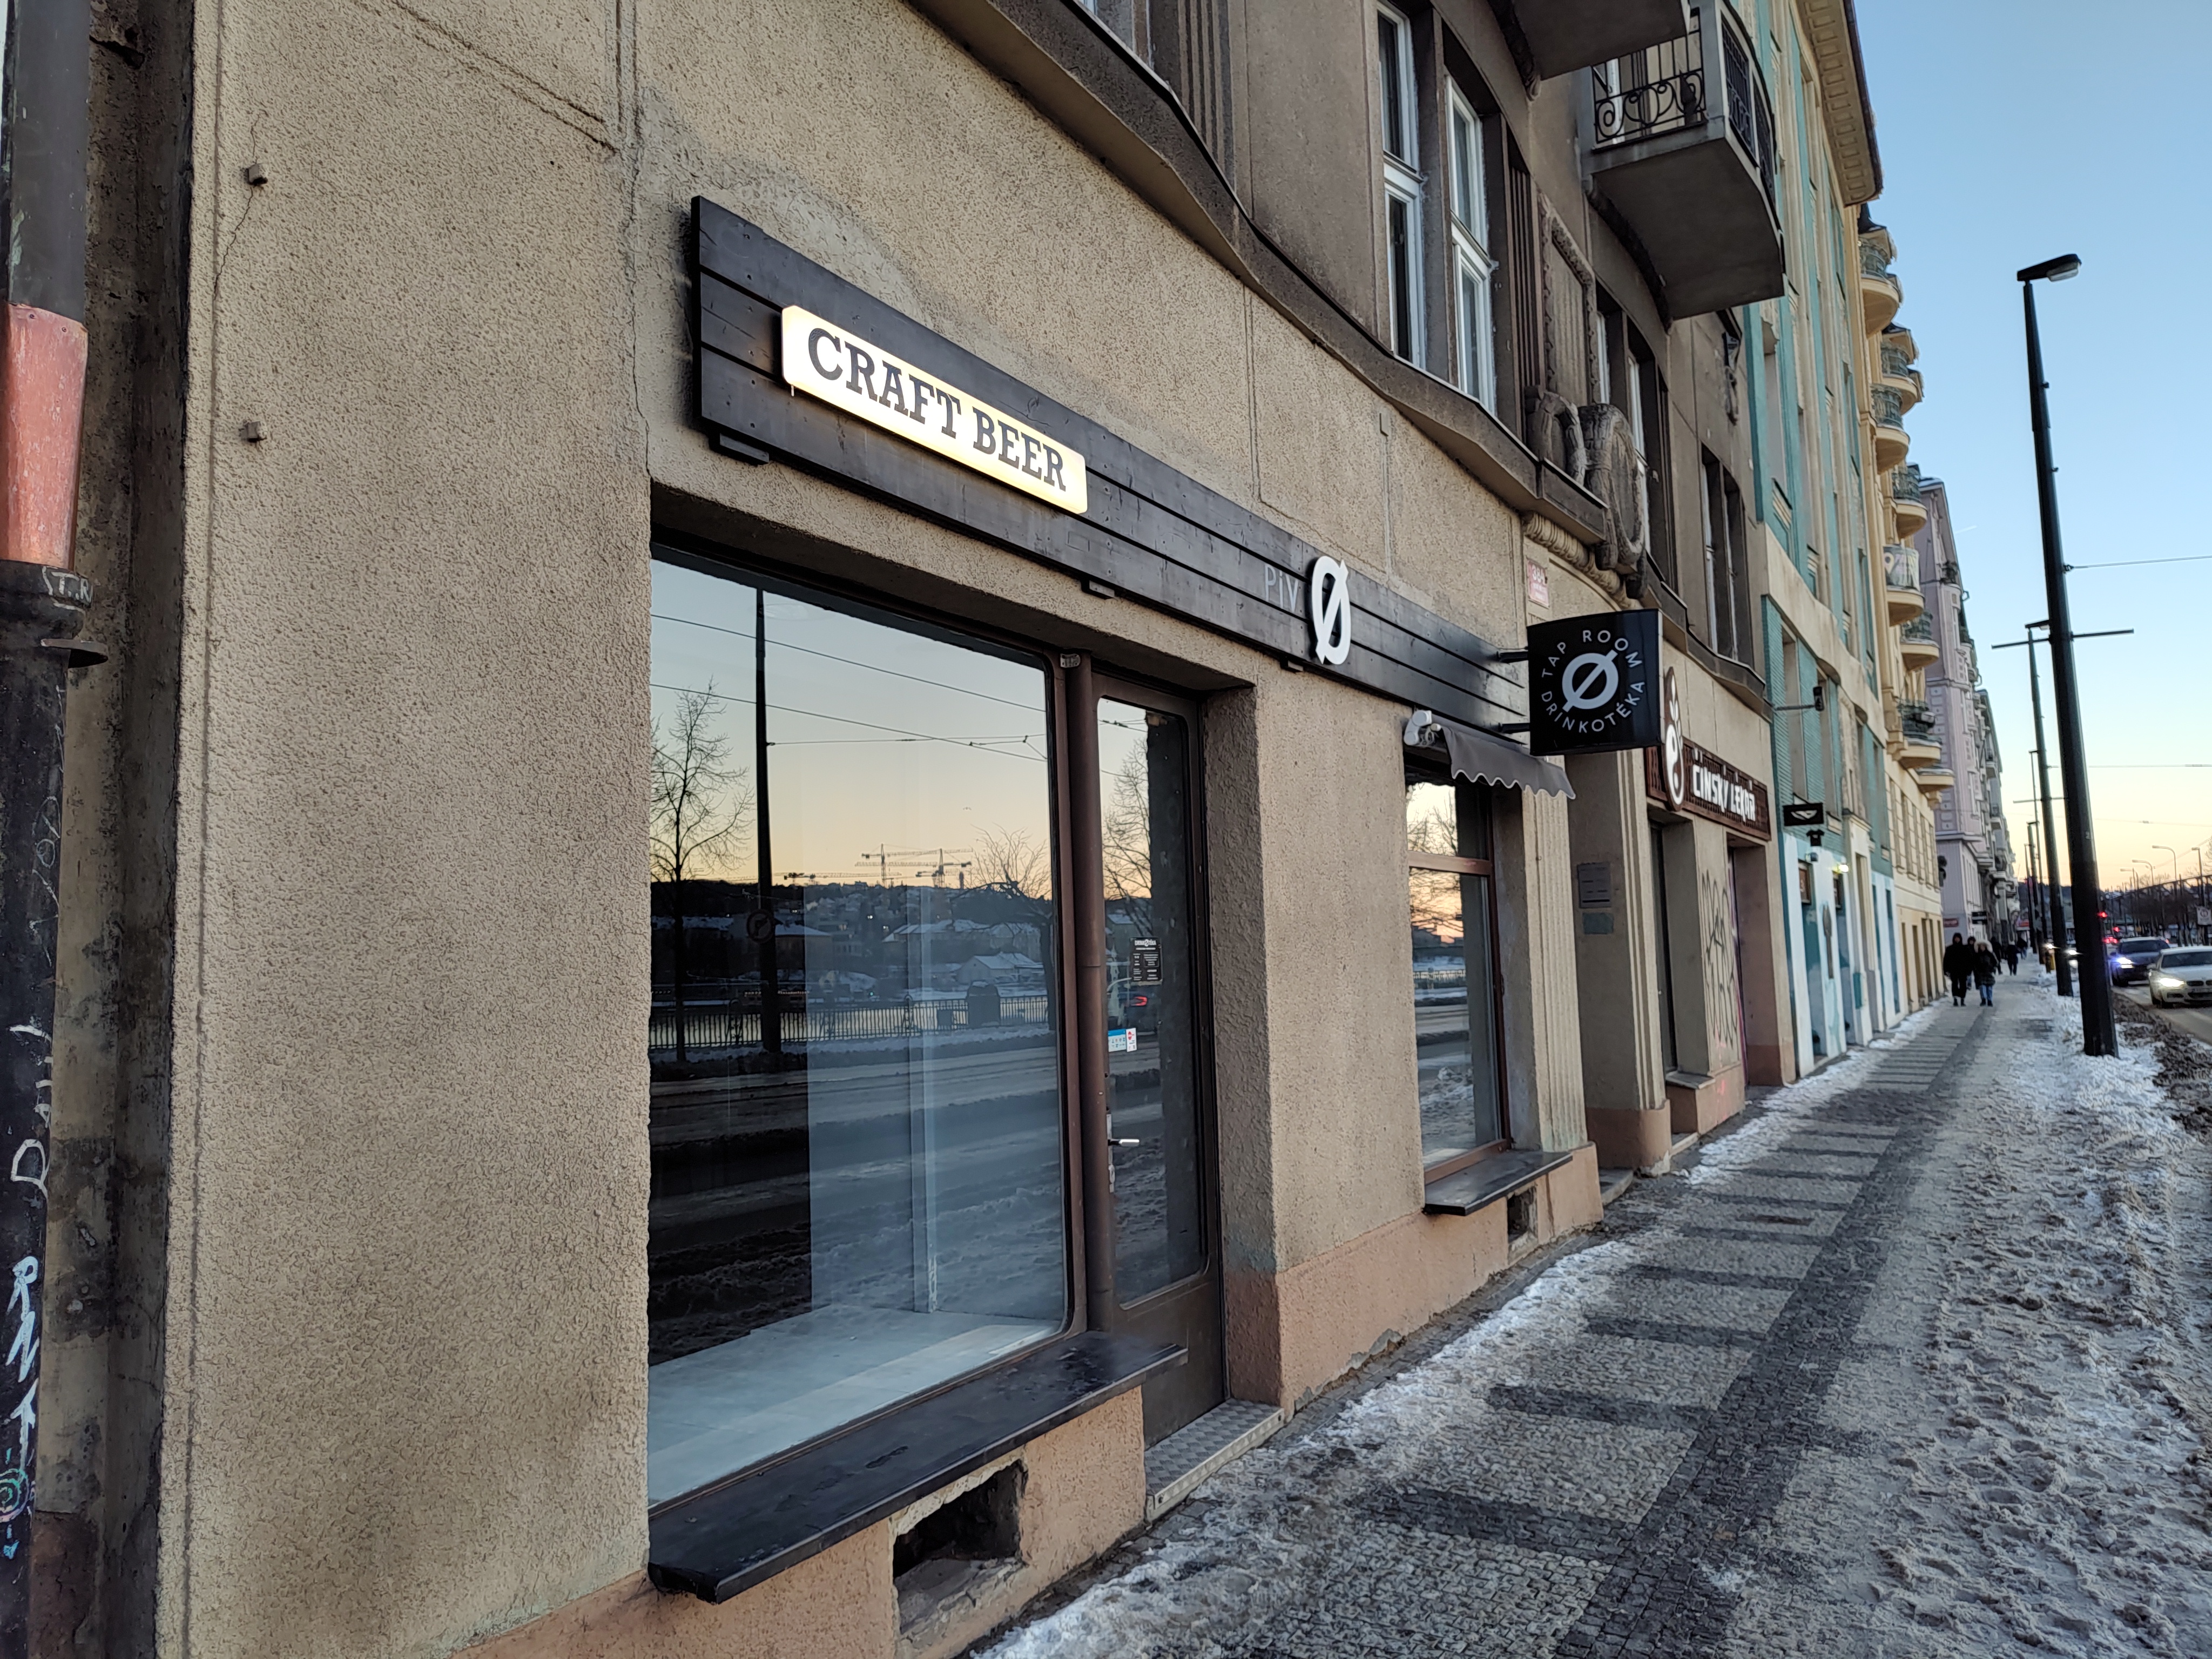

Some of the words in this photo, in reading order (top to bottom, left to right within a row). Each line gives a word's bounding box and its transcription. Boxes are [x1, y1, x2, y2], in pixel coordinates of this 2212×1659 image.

[808, 328, 961, 439] CRAFT
[973, 406, 1066, 491] BEER
[1541, 642, 1566, 678] TAP
[1582, 630, 1642, 668] ROOM
